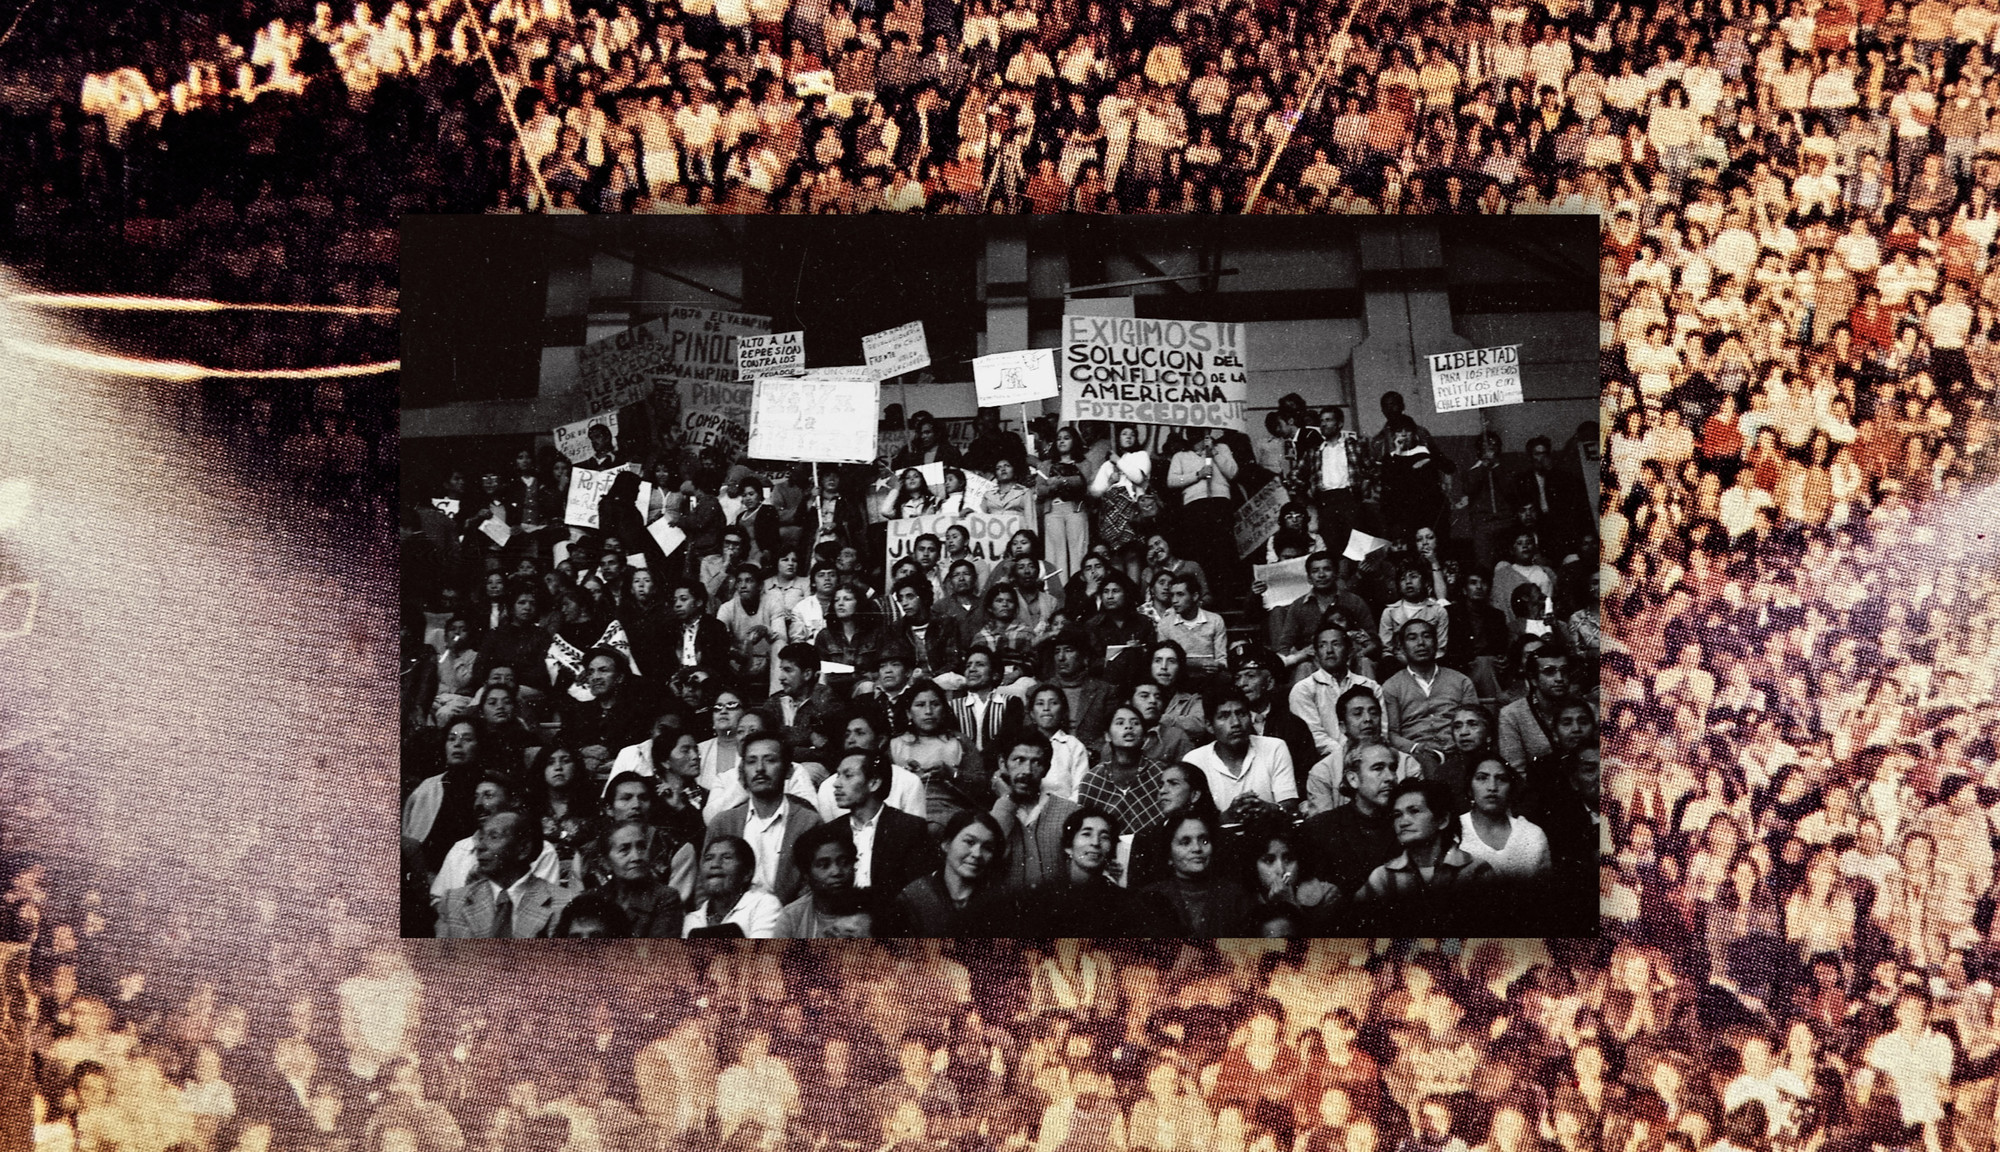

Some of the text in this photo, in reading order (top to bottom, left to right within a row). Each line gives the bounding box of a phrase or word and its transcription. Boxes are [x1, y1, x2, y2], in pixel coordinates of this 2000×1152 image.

[703, 321, 721, 332] DE
[728, 314, 772, 331] VAMPIR
[739, 334, 796, 348] ALTO A LA
[1069, 317, 1236, 356] EXIGIMOS!!
[672, 330, 737, 364] PINOC
[740, 345, 802, 358] REPRESION
[741, 355, 796, 368] CONTRA LOS
[1068, 344, 1243, 371] SOLUCION DEL
[1433, 347, 1516, 372] LIBERTAD
[1070, 364, 1247, 387] CONFLICTO DE LA
[1440, 372, 1461, 384] PARA
[1485, 366, 1518, 378] PRESOS
[1081, 383, 1228, 403] AMERICANA
[588, 394, 615, 414] DE
[1437, 397, 1462, 410] CHILE
[578, 471, 615, 502] Rupt
[893, 518, 922, 537] LA
